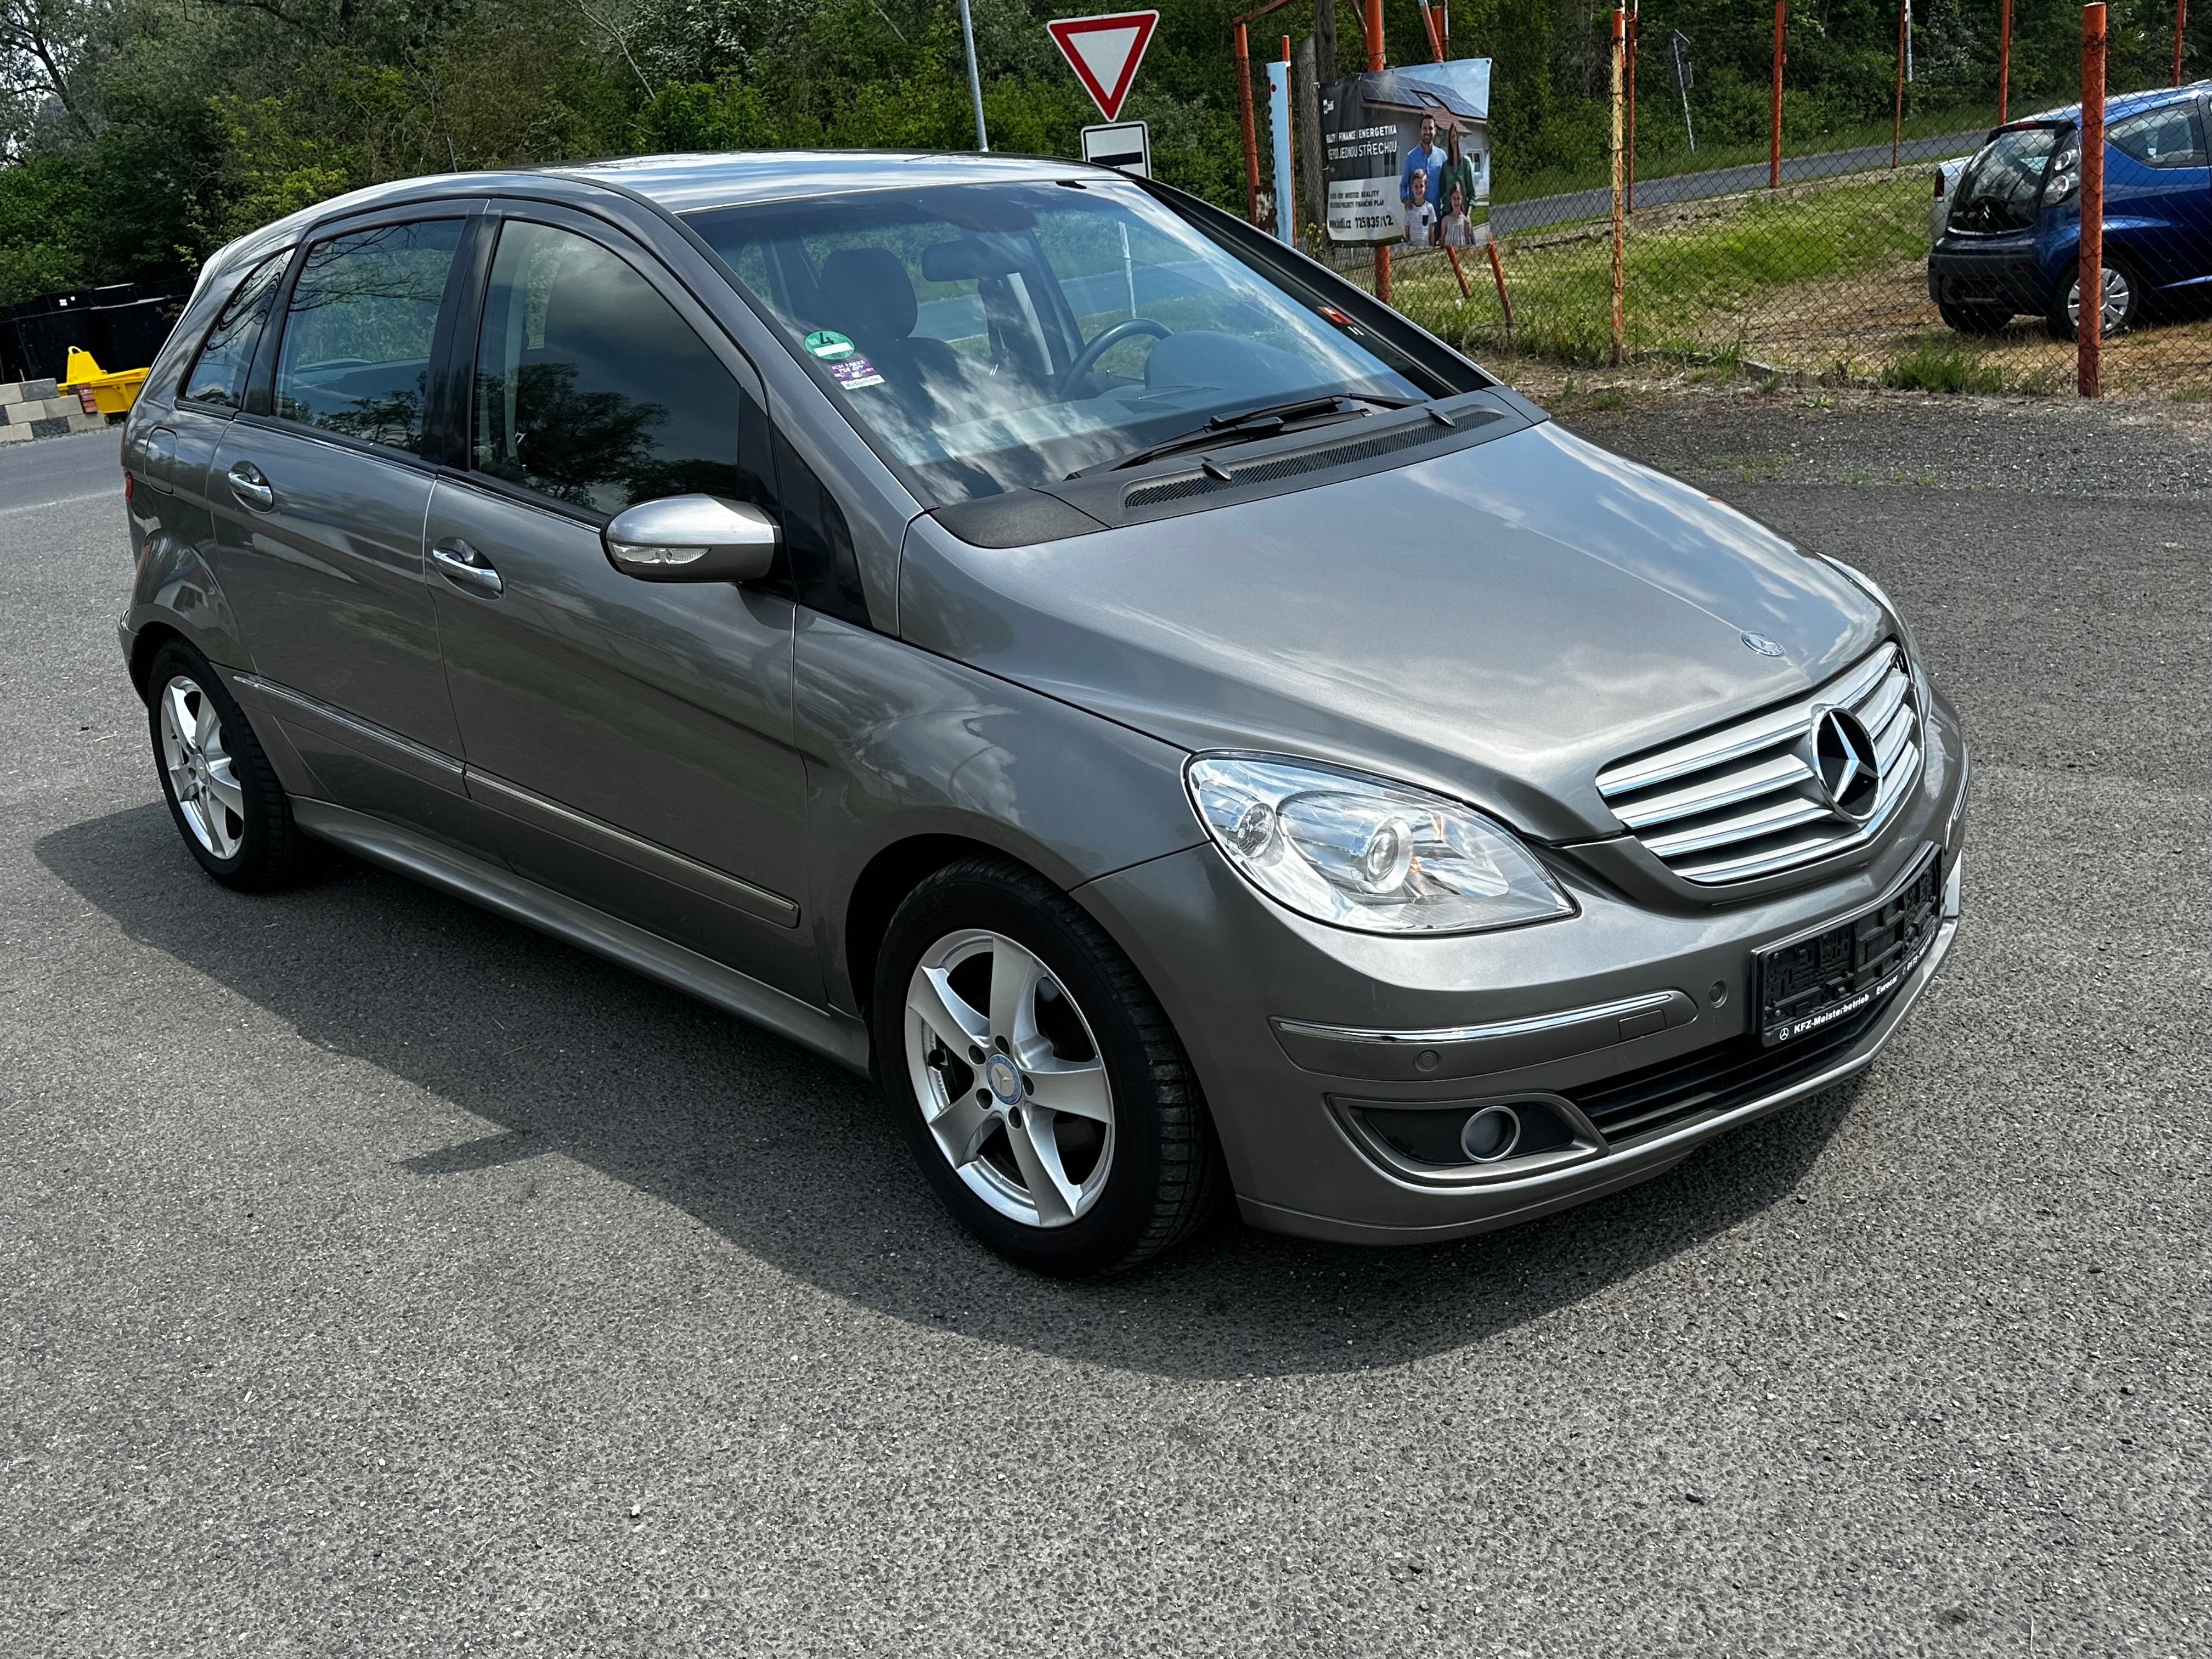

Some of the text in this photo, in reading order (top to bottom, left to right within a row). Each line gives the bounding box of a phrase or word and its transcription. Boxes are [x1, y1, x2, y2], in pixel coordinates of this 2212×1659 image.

[1358, 124, 1397, 139] ENERGETIKA
[1358, 140, 1397, 157] STŘECHOU
[820, 332, 834, 345] 4
[1793, 975, 1898, 1034] KFZ-Meisterbetrieb Eurocar
